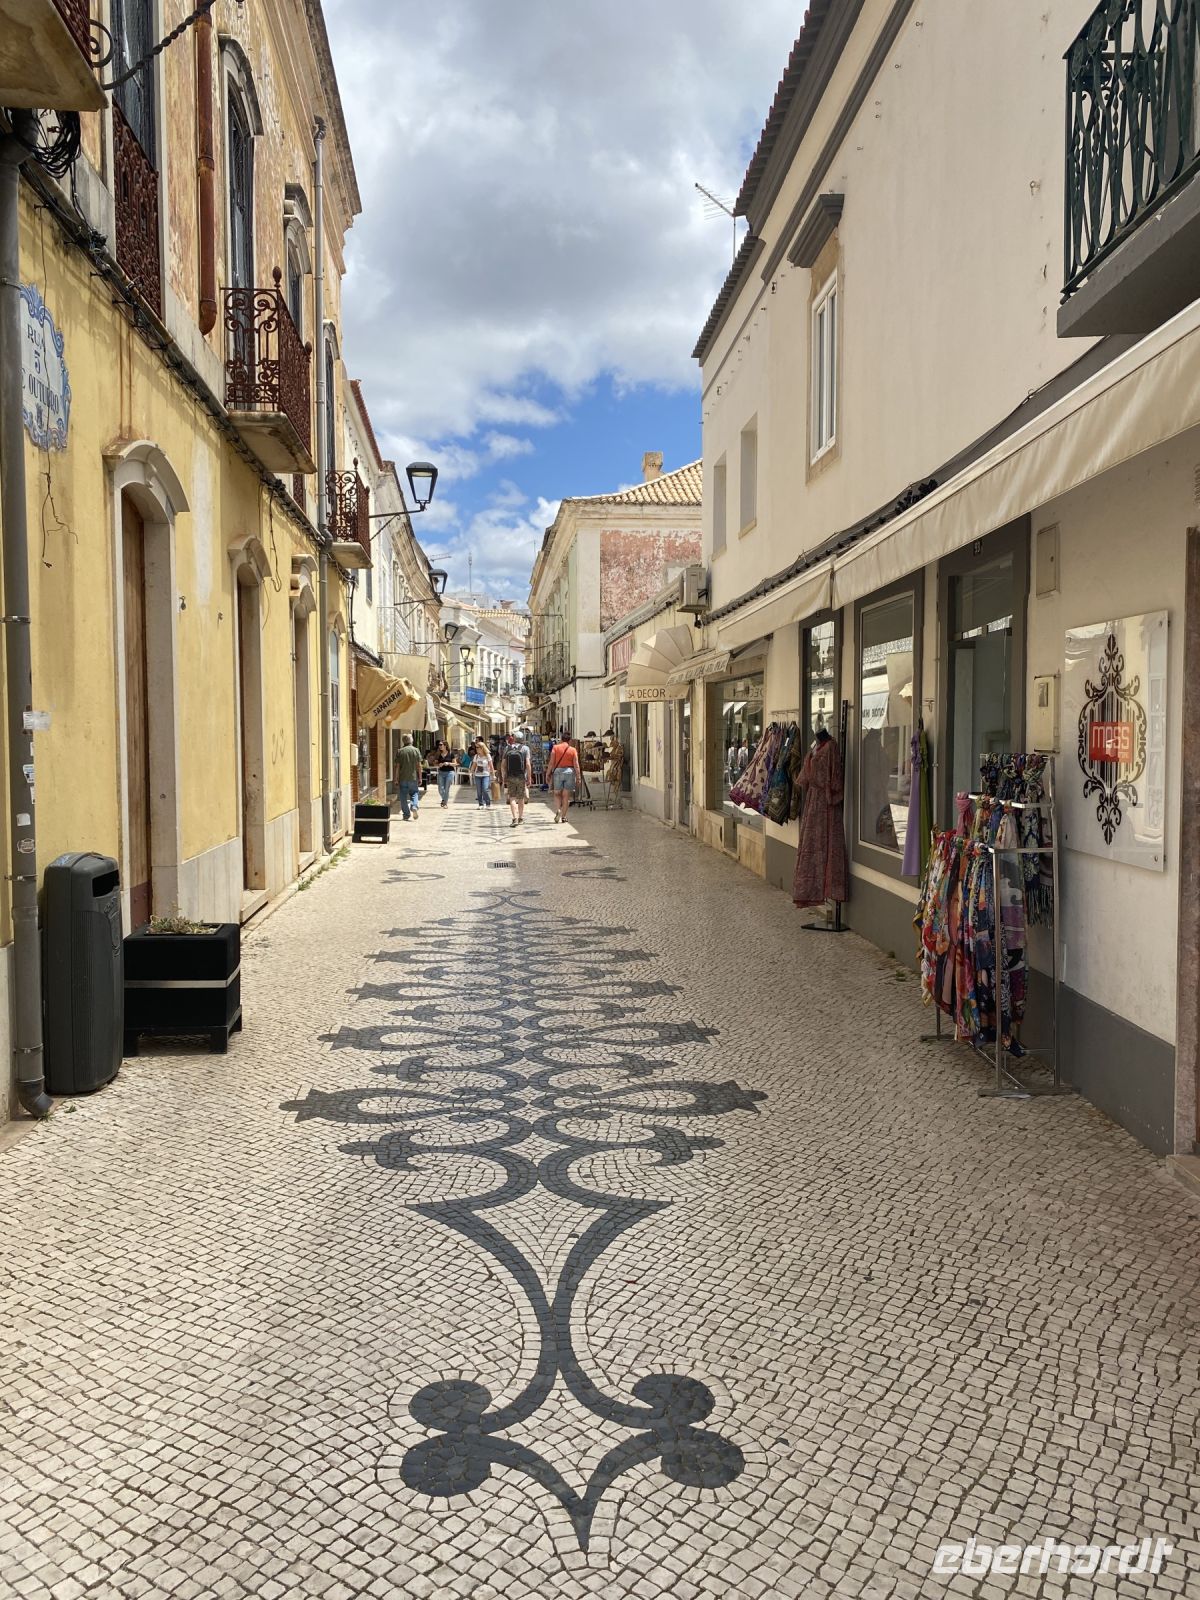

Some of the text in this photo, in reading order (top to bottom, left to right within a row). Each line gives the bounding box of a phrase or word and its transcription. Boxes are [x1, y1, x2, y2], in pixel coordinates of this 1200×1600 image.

[27, 324, 45, 350] RUA
[34, 350, 41, 374] 5
[372, 689, 402, 717] SAPATARIA
[637, 688, 666, 698] DECOR
